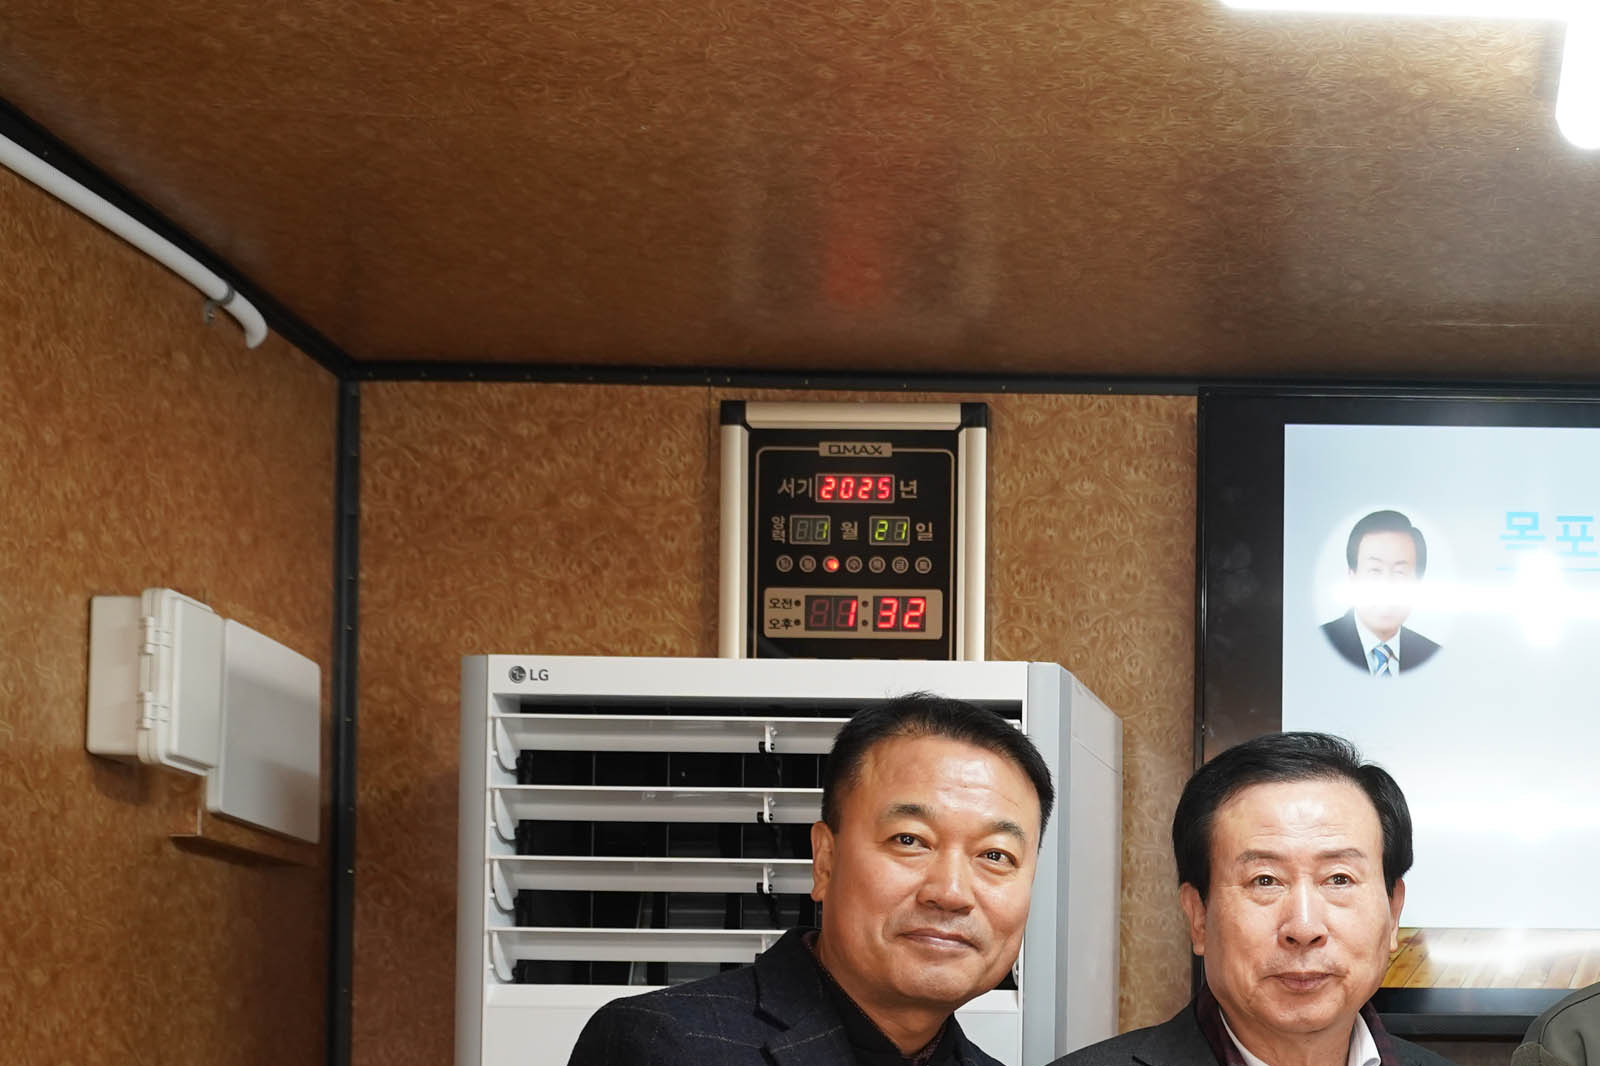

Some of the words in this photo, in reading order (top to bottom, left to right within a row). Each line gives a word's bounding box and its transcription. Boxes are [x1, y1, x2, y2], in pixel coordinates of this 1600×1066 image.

[777, 477, 812, 499] 서기
[820, 476, 892, 499] 2025
[900, 479, 917, 498] 년
[874, 520, 908, 541] 21
[915, 521, 933, 541] 일
[530, 668, 549, 681] LG
